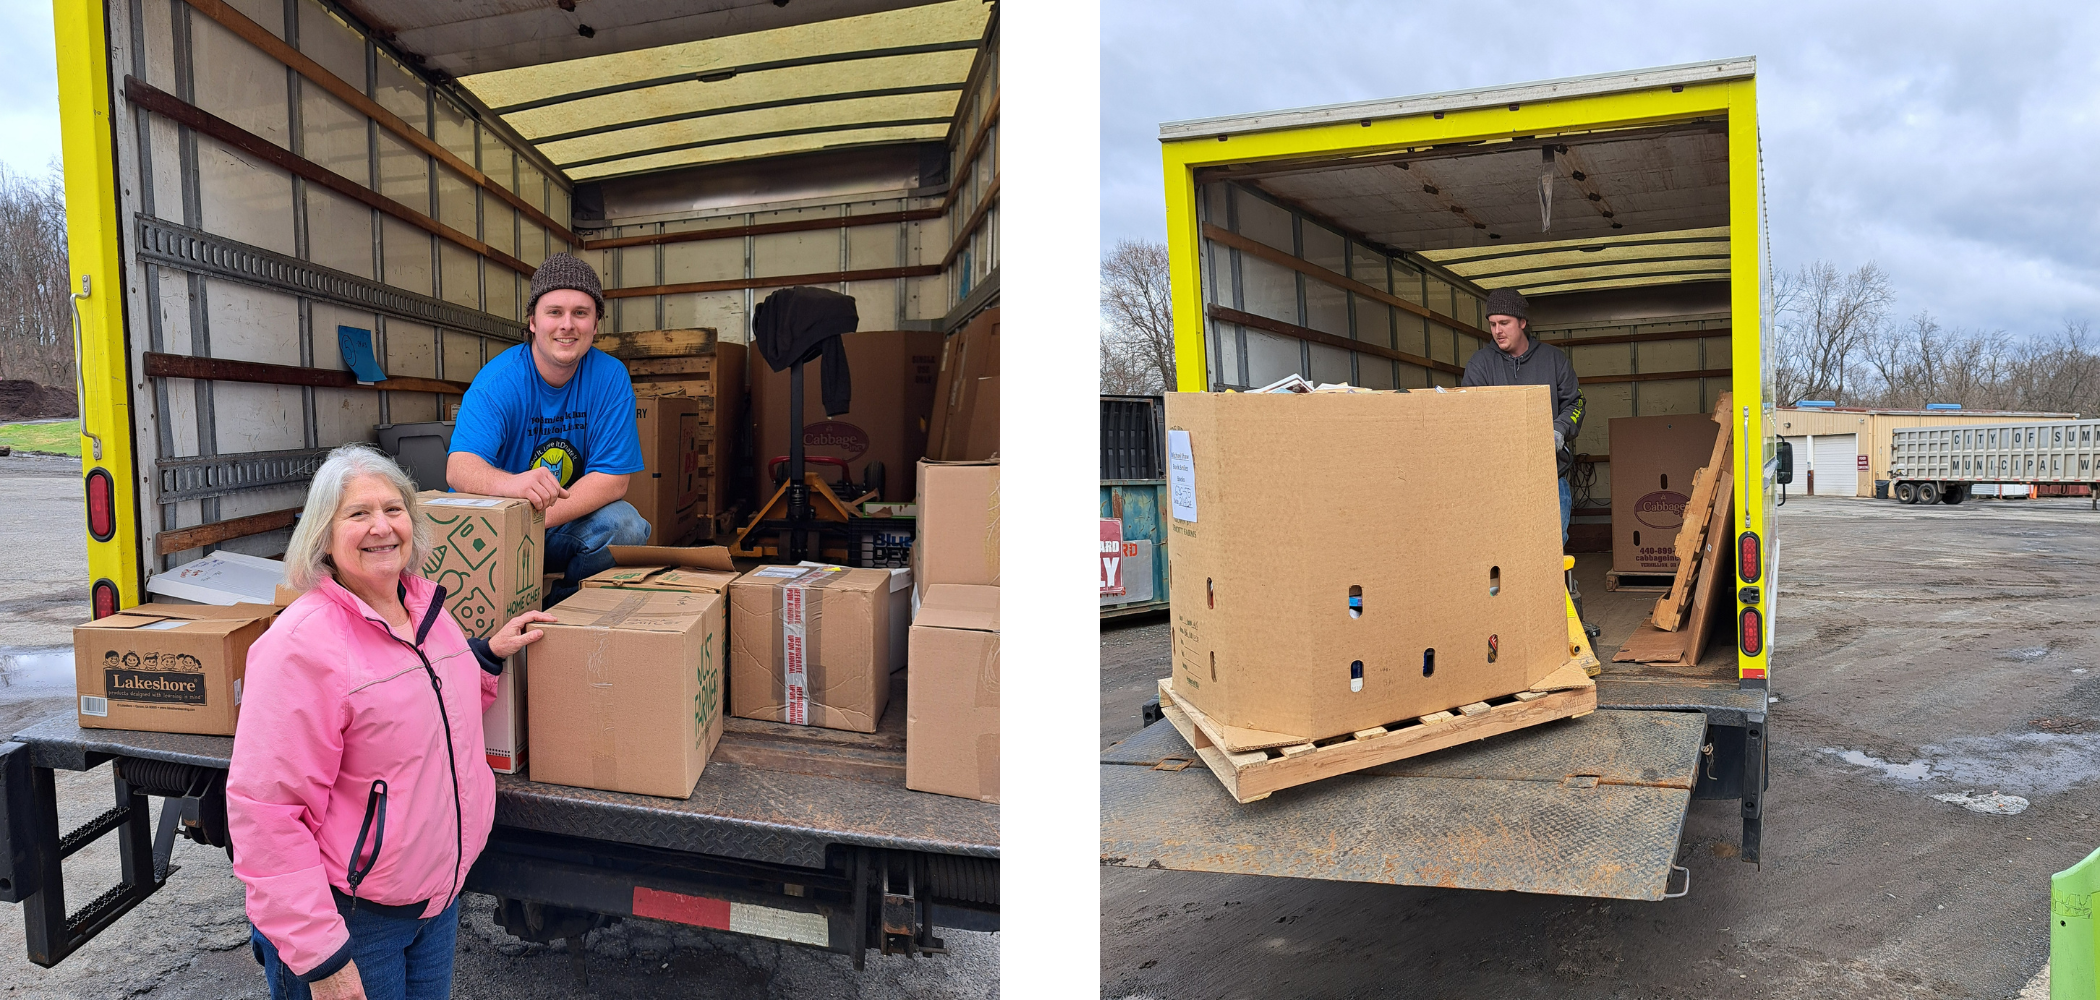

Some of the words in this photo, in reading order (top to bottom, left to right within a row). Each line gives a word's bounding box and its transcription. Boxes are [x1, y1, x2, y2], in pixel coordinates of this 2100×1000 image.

[803, 434, 858, 449] Cabbage
[1954, 434, 1996, 445] CITY
[2015, 432, 2034, 443] OF
[1952, 460, 2060, 471] MUNICIPAL
[1642, 502, 1686, 514] Cabbage
[1100, 541, 1120, 552] ARD
[507, 595, 526, 618] HOME
[526, 586, 540, 606] CHEF
[697, 632, 712, 686] JUST
